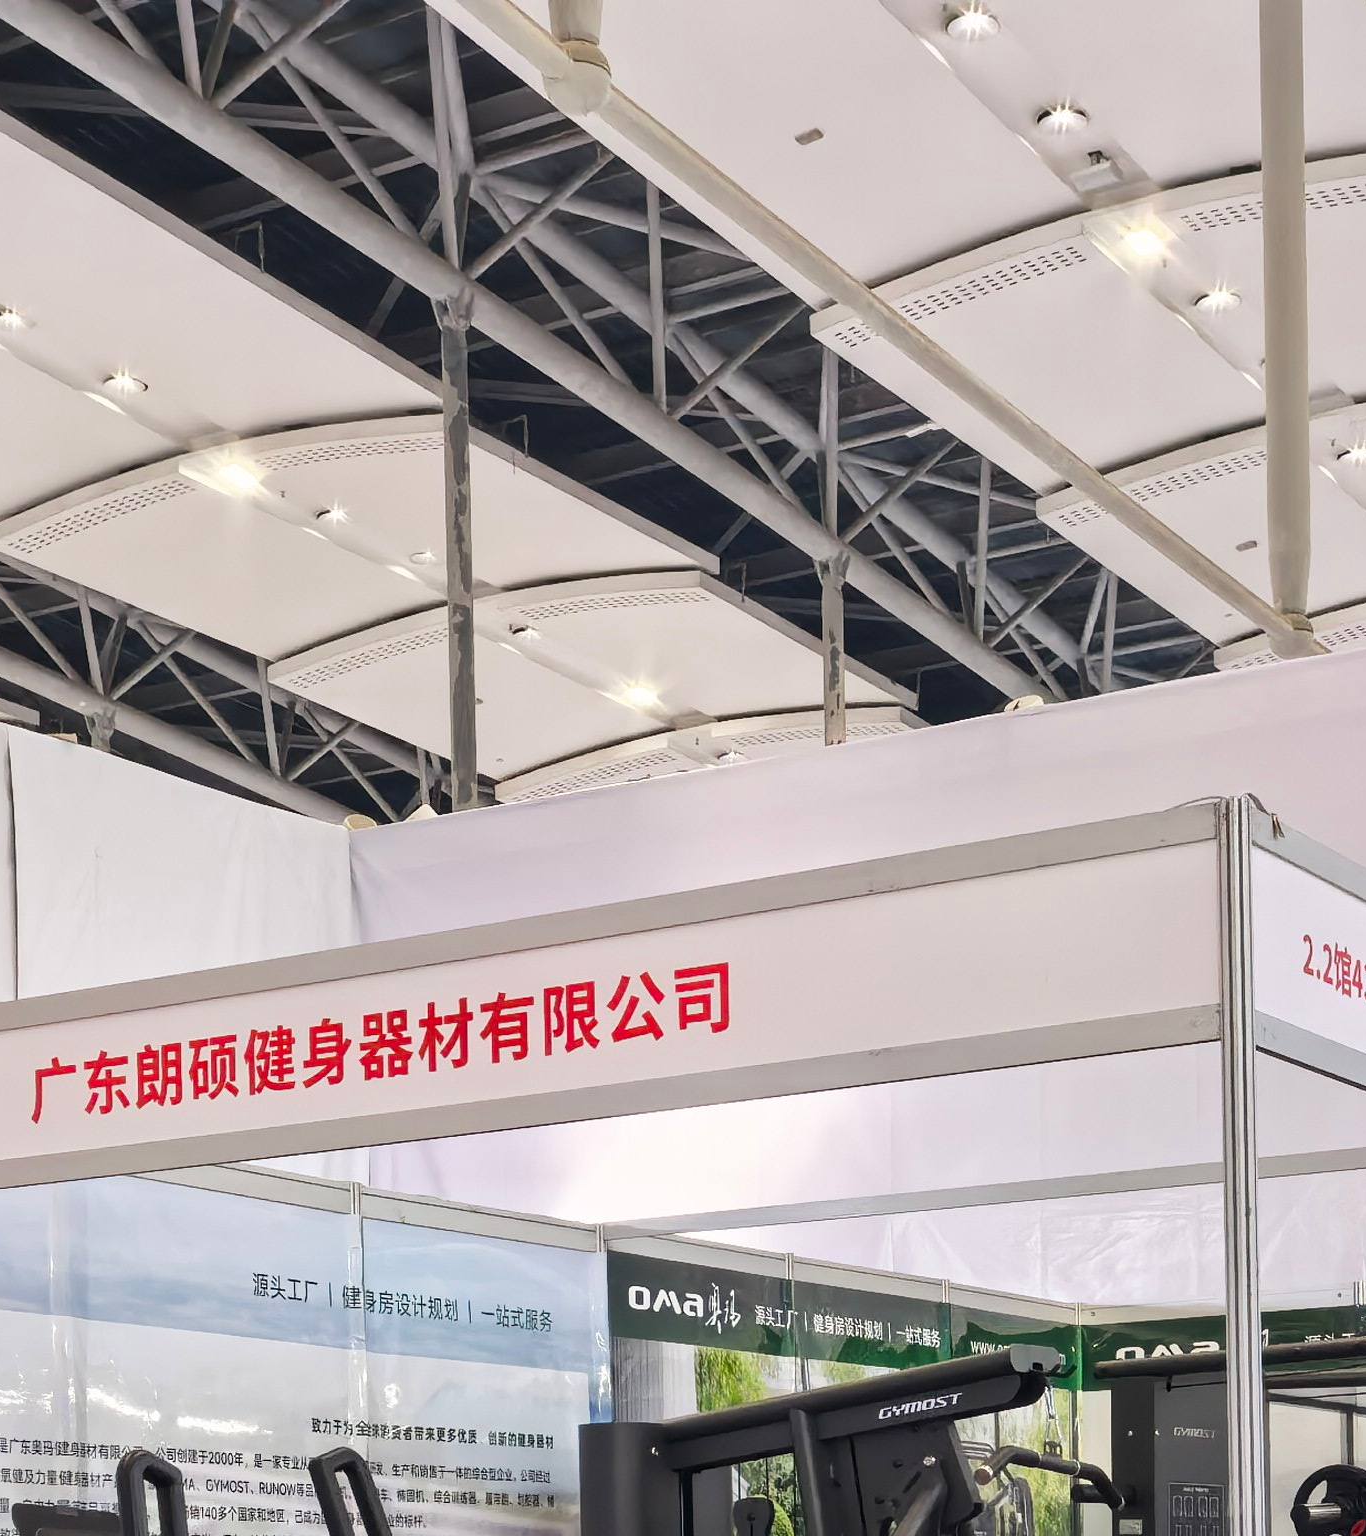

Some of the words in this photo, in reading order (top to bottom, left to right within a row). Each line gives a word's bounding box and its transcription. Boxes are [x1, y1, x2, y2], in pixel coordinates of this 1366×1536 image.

[31, 962, 732, 1123] 广东朗硕健身器材有限公司
[252, 1272, 318, 1303] 源头工厂
[342, 1285, 459, 1323] 健身房设计规划
[481, 1303, 553, 1332] 一站式服务
[814, 1313, 883, 1341] 健身房设计规划
[896, 1325, 941, 1348] 一站式服务
[879, 1392, 963, 1419] GYMOST
